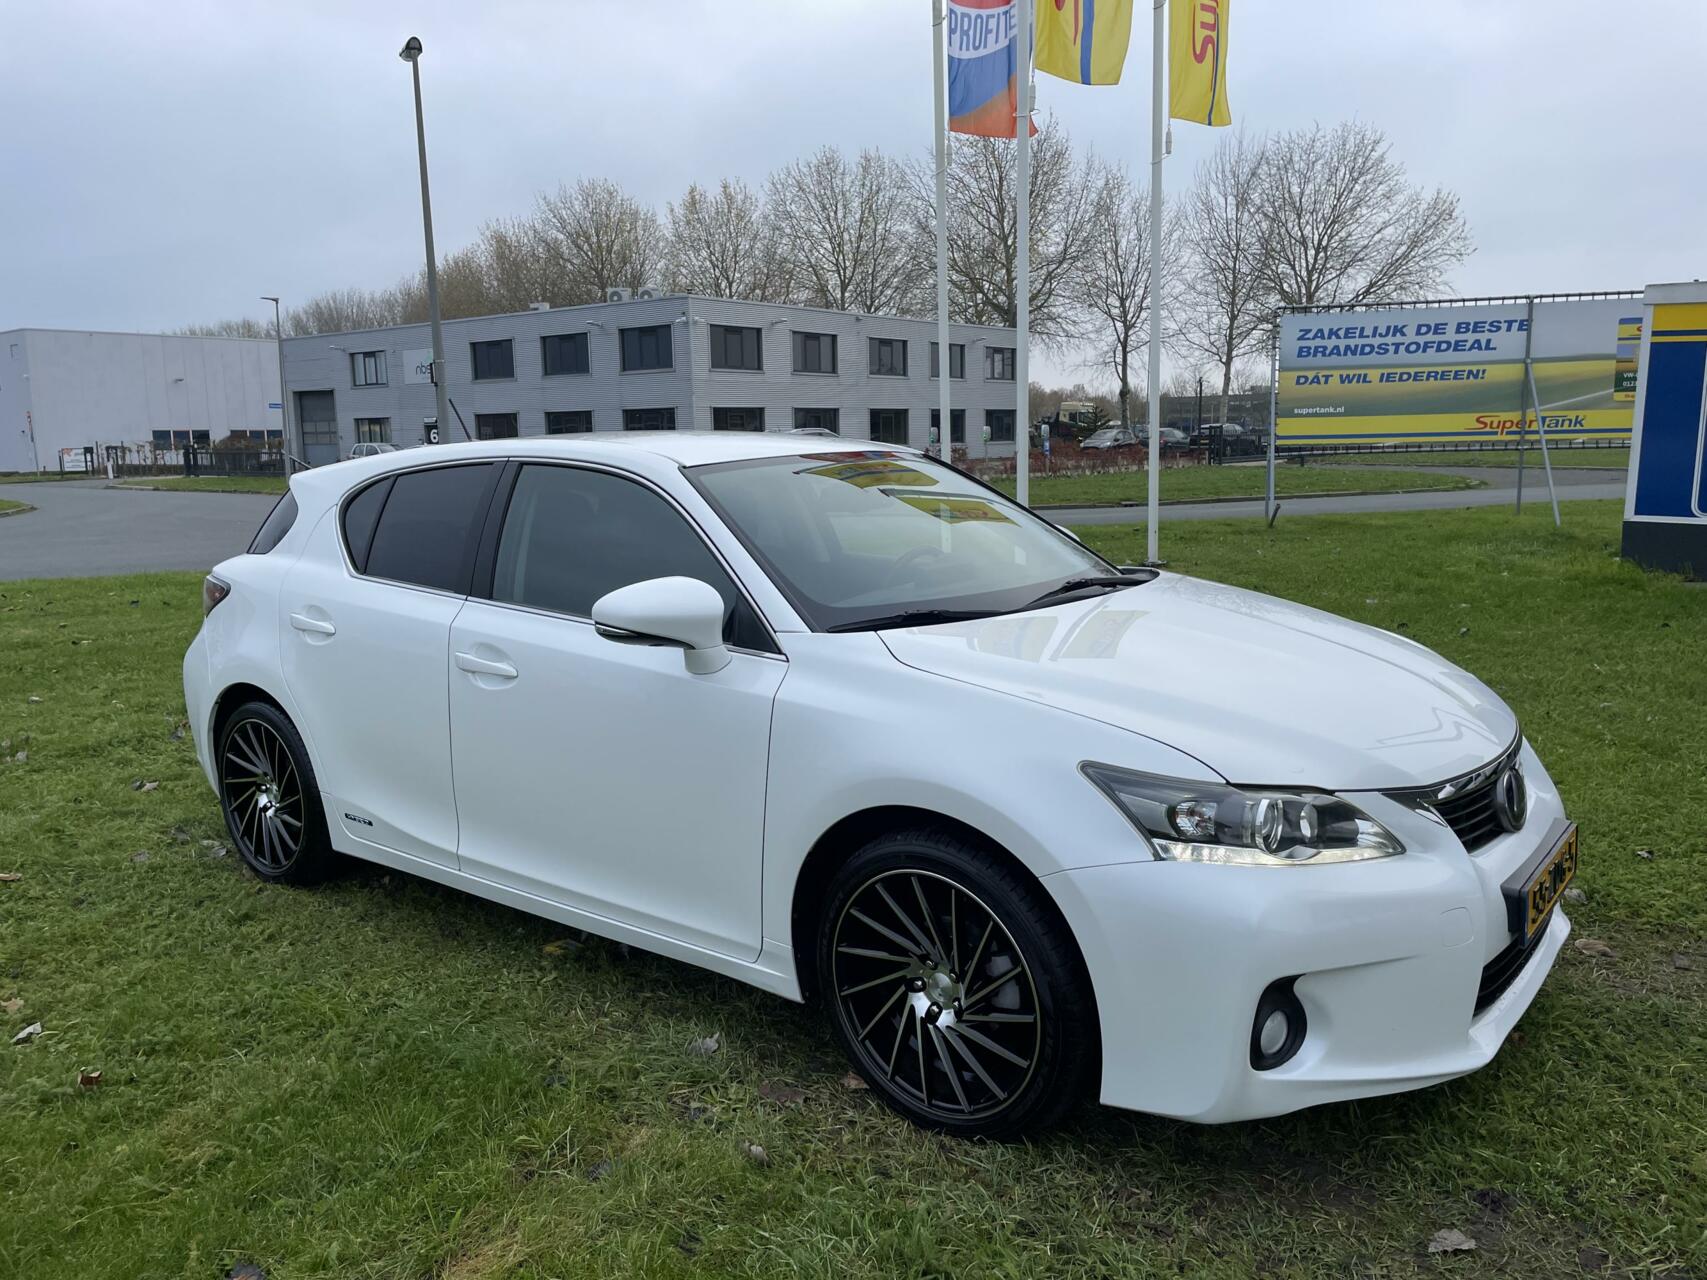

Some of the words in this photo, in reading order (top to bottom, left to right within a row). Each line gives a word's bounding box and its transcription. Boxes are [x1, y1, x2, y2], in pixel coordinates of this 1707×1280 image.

[1296, 324, 1409, 341] ZAKELIJK
[1415, 322, 1448, 336] DE
[1454, 319, 1529, 335] BESTE
[1296, 338, 1497, 358] BRANDSTOFDEAL
[1339, 373, 1373, 384] WIL
[1379, 369, 1487, 383] IEDEREEN!
[1294, 405, 1345, 415] supertank.nl
